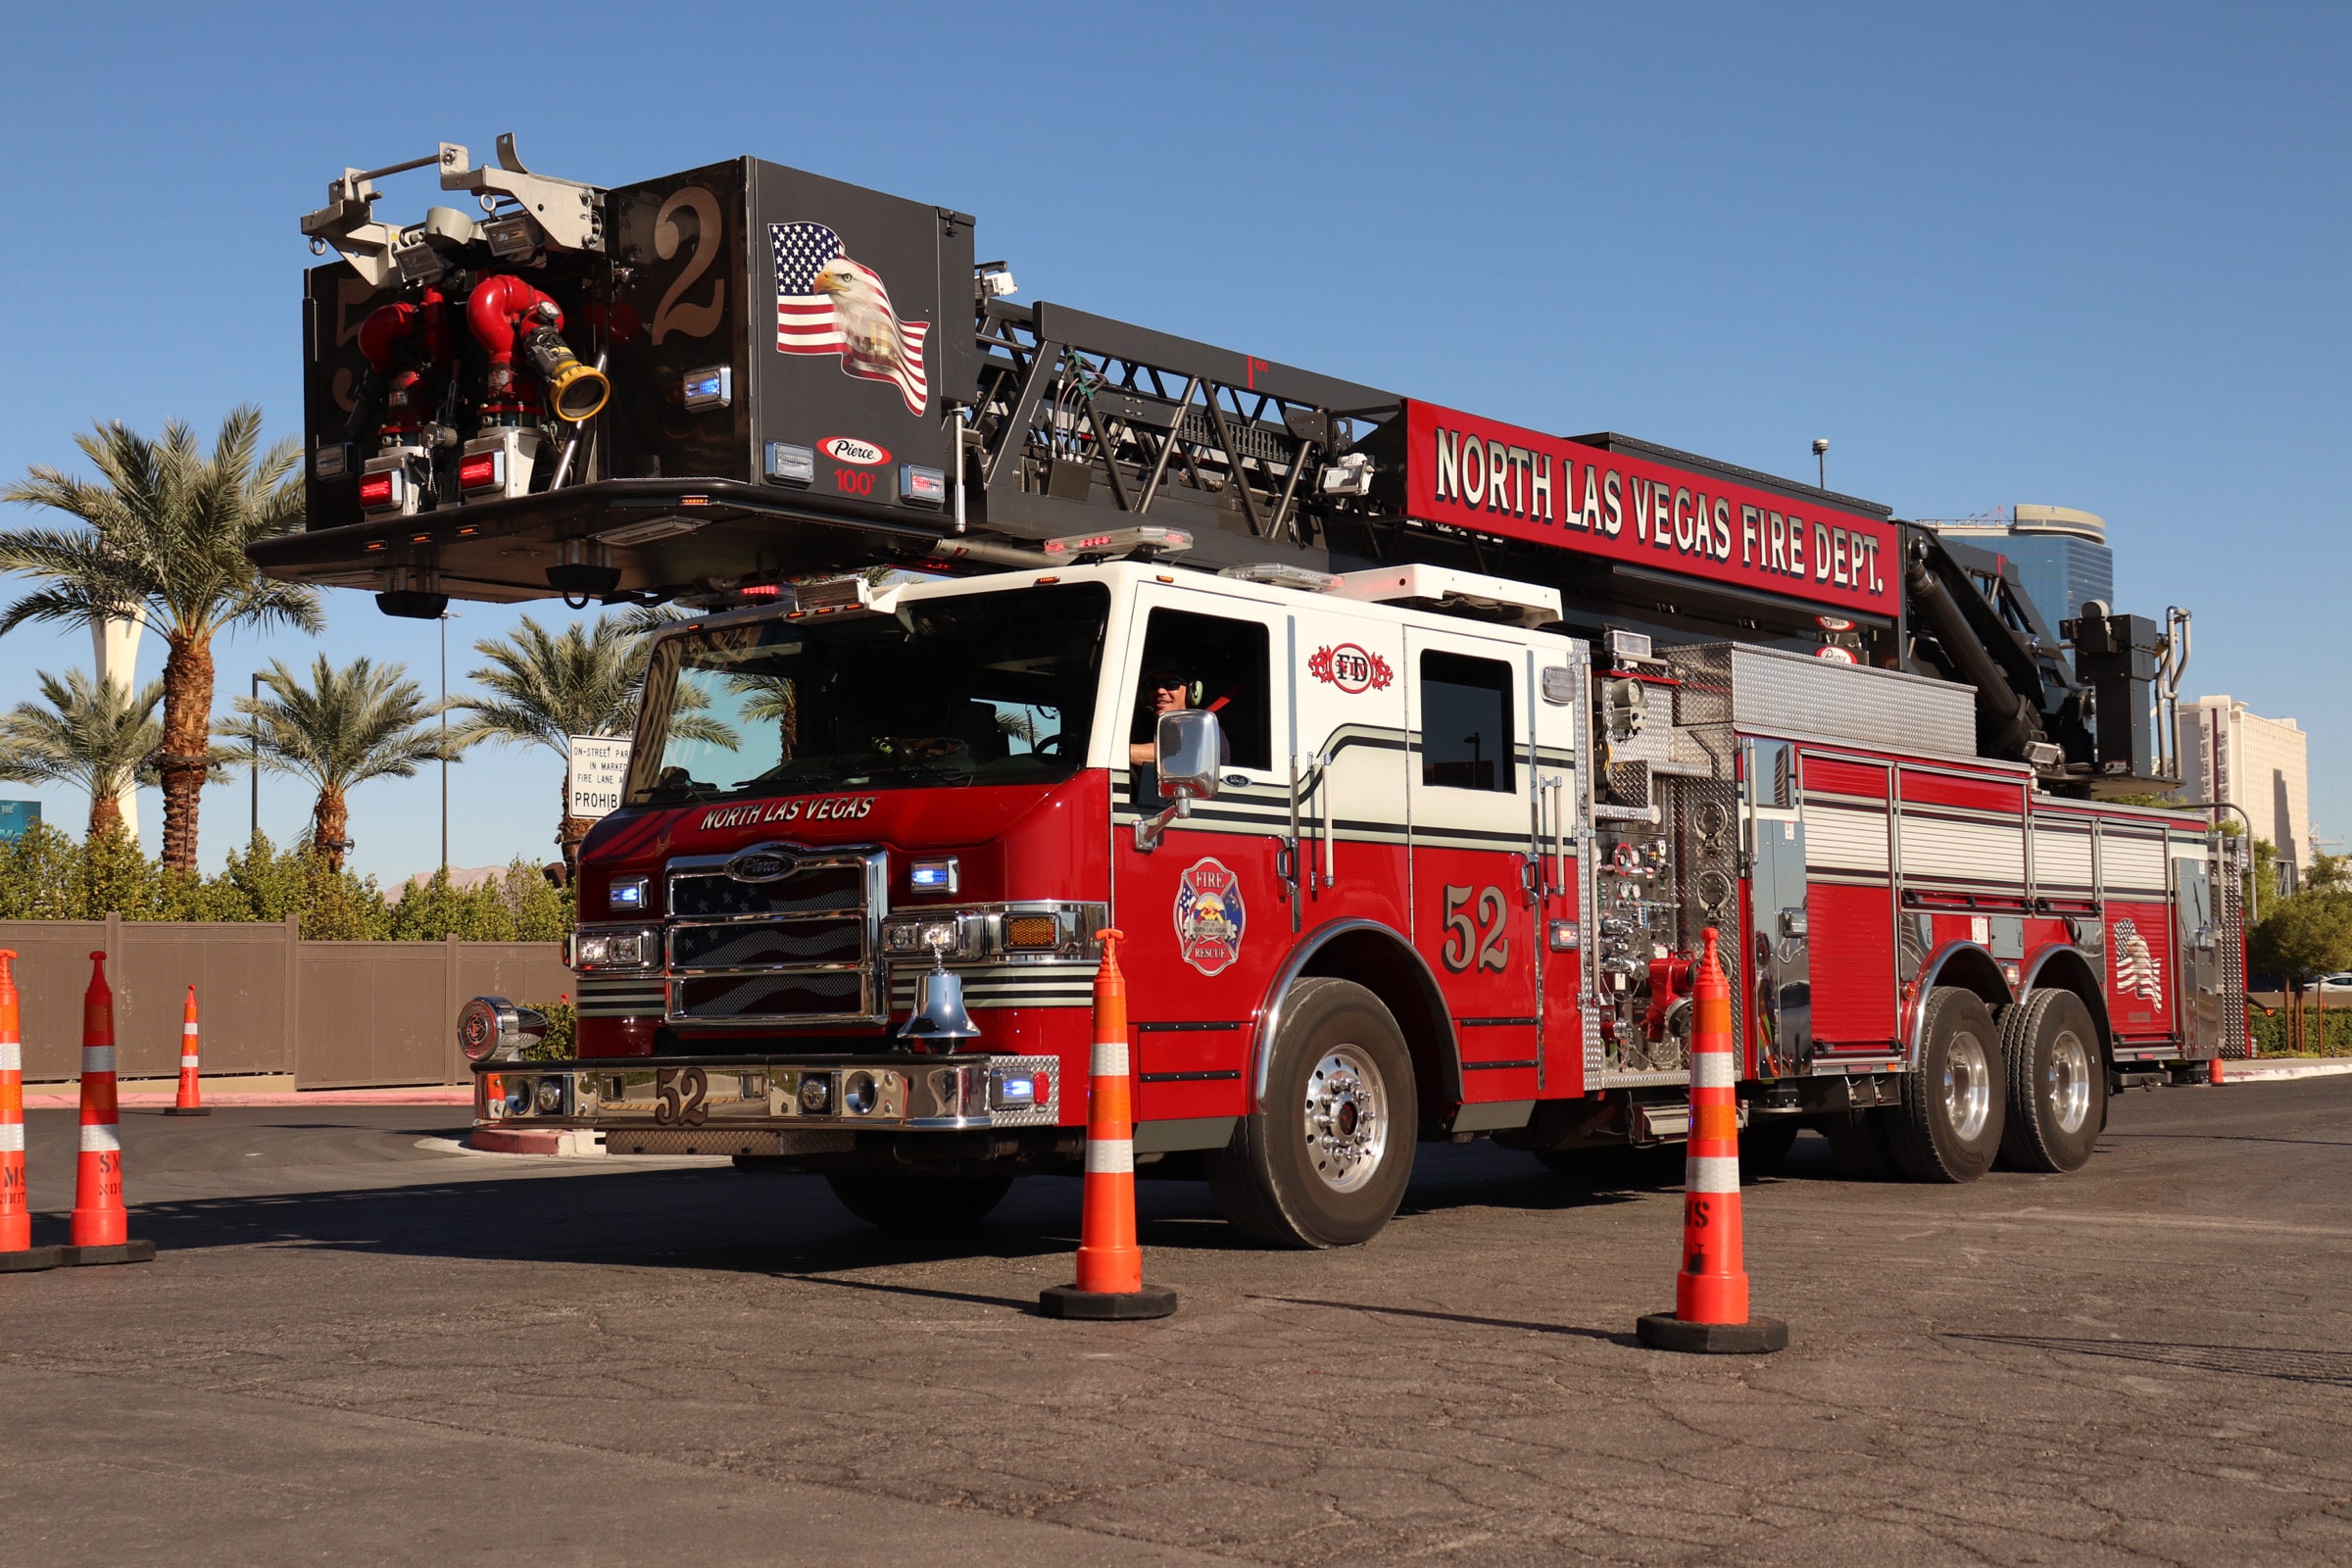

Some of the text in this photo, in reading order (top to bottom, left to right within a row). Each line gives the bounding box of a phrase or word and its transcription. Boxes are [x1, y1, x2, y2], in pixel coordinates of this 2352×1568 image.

[651, 185, 725, 346] 2
[834, 439, 876, 461] Pierce
[834, 467, 877, 497] 100'
[1435, 426, 1885, 596] NORTH LAS VEGAS FIRE DEPT.
[574, 747, 611, 759] ON-STREET
[590, 761, 597, 770] IN
[577, 773, 592, 783] FIRE
[597, 775, 613, 785] LANE
[575, 792, 621, 808] PROHIB
[700, 796, 876, 831] NORTH LAS VEGAS
[1196, 871, 1225, 888] FIRE
[1442, 883, 1510, 975] 52
[1195, 947, 1226, 958] RESCUE
[655, 1067, 709, 1126] 52
